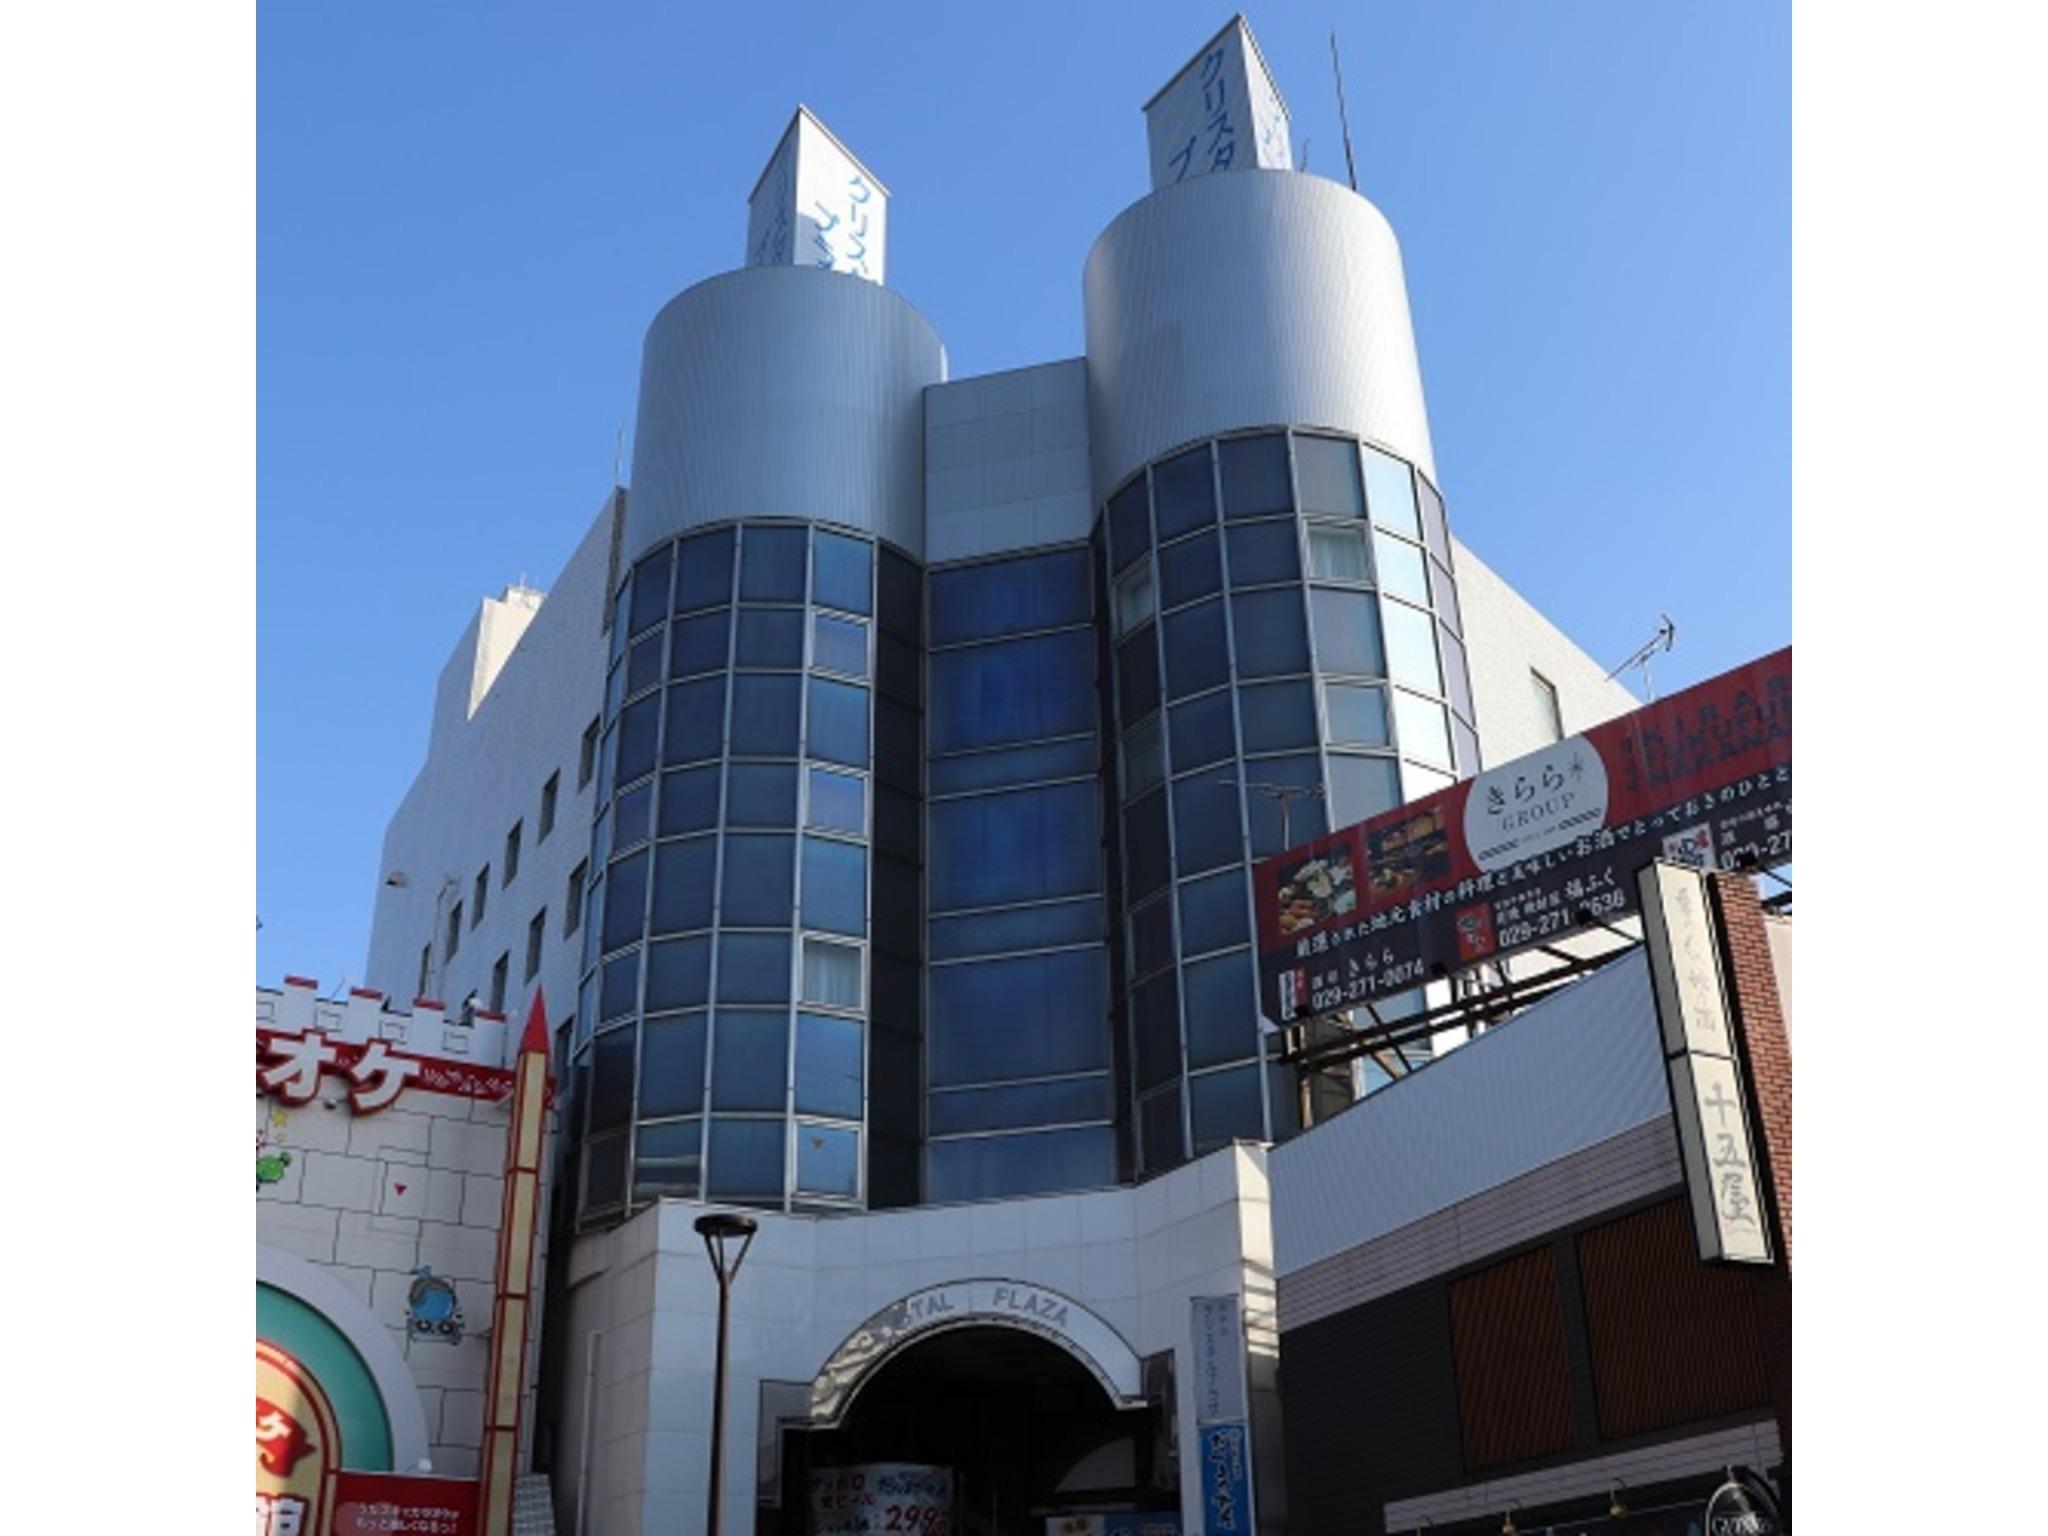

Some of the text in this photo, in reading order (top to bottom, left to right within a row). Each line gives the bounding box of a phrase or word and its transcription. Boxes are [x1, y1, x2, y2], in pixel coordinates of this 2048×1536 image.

[1501, 791, 1576, 833] GROUP
[1704, 1080, 1756, 1226] 十五屋
[992, 1286, 1068, 1328] PLAZA
